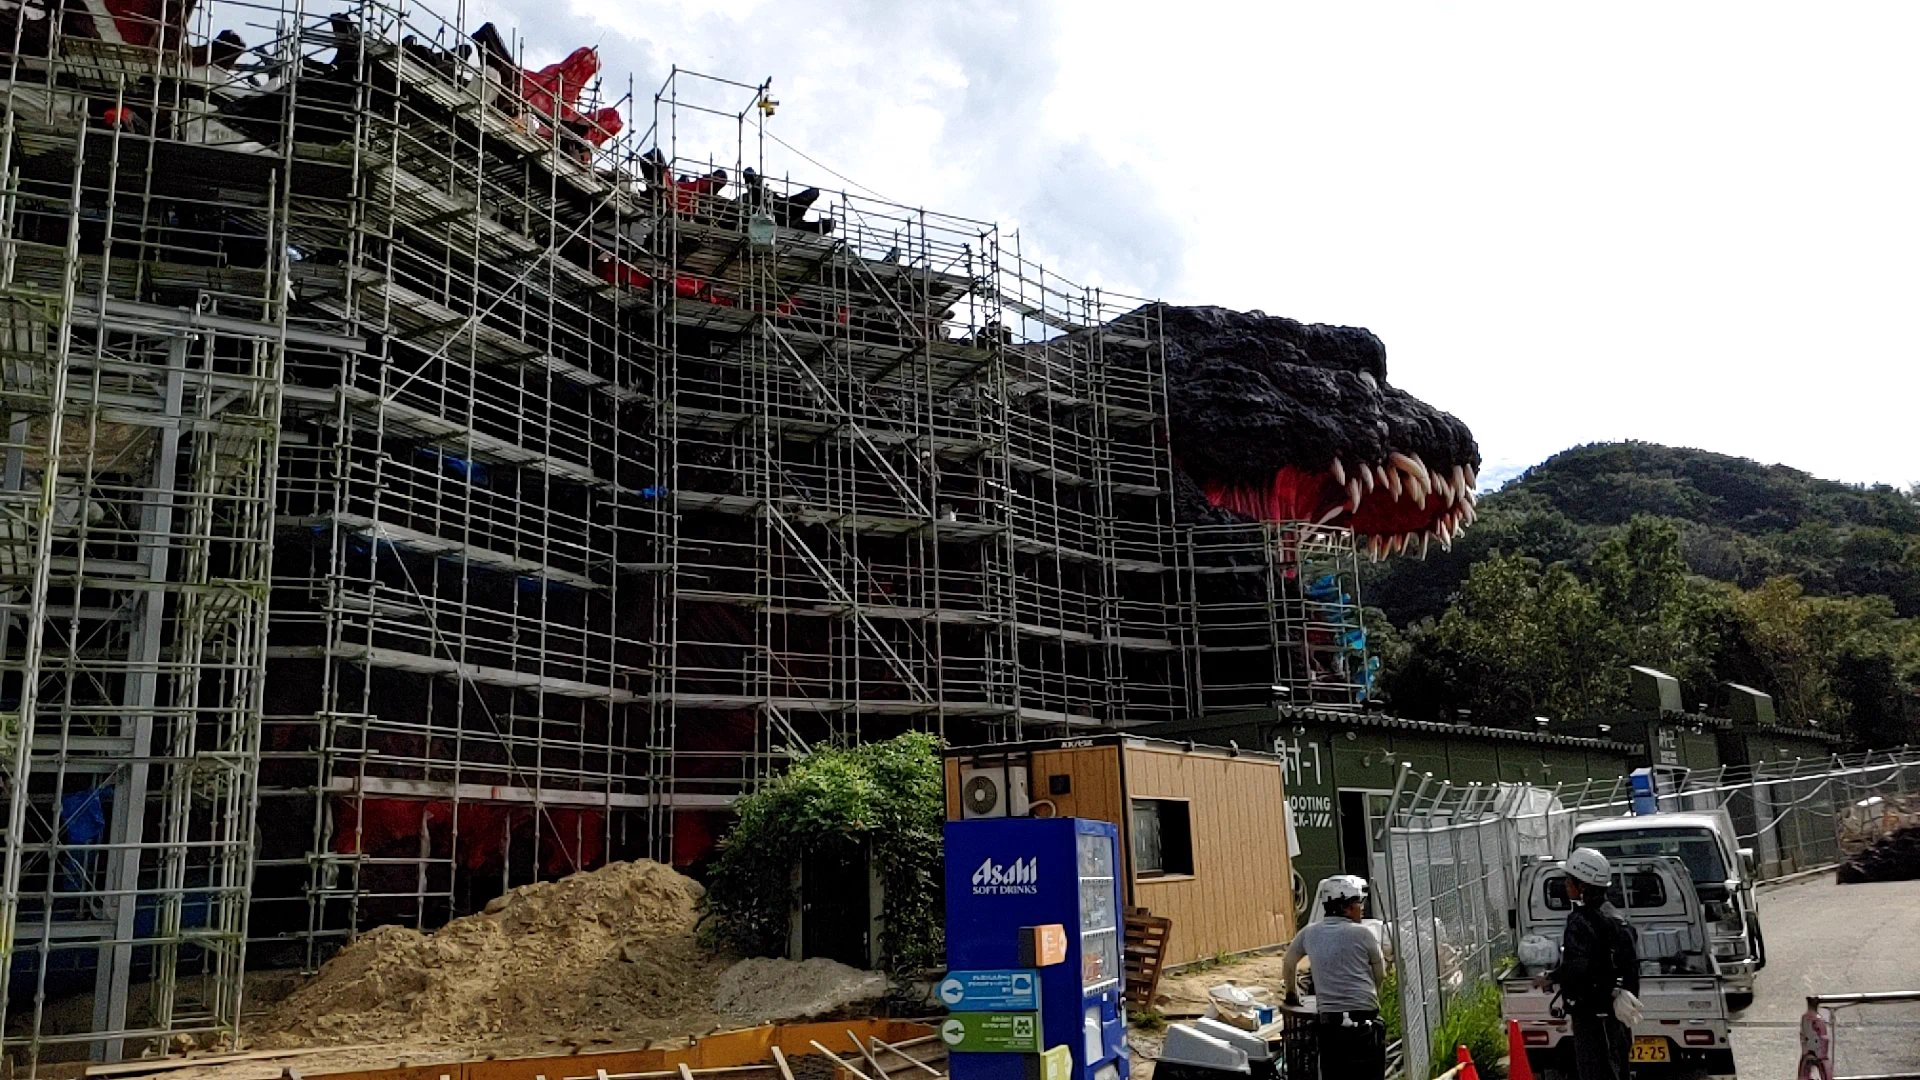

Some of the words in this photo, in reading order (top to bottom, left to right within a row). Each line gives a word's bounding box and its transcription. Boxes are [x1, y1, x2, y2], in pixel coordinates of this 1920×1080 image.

[1286, 795, 1331, 811] OOTING
[972, 856, 1037, 885] Asahi
[973, 886, 998, 894] SOFT
[1000, 885, 1037, 895] DRINKS
